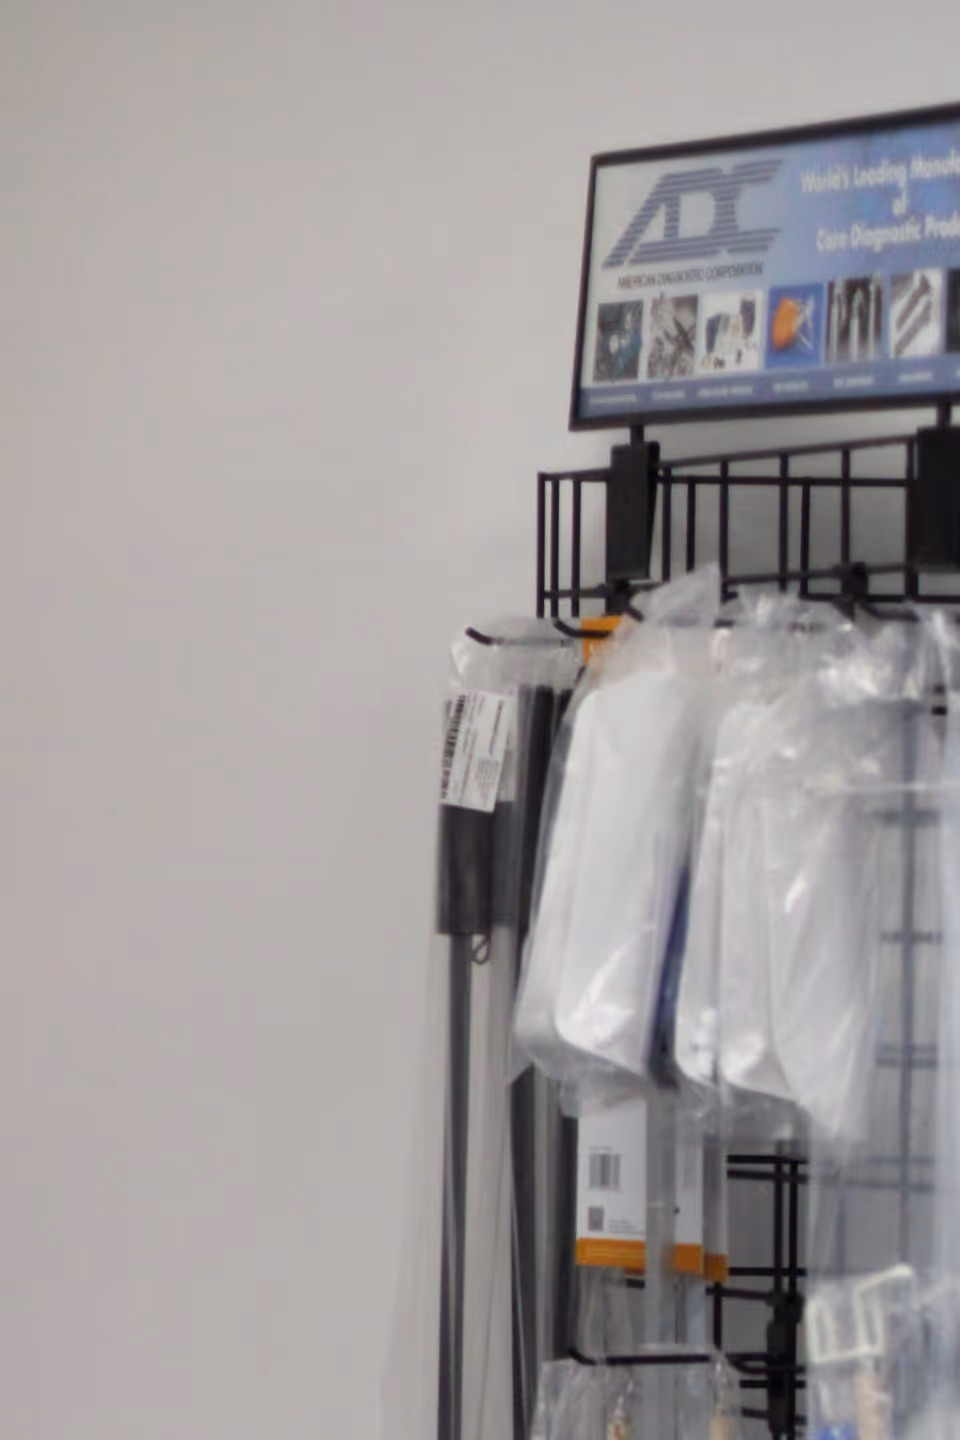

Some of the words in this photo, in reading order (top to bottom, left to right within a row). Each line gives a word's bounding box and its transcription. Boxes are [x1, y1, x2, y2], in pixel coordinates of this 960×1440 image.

[854, 158, 908, 189] Leading
[602, 158, 784, 270] ADC
[851, 217, 921, 253] Diagnostic
